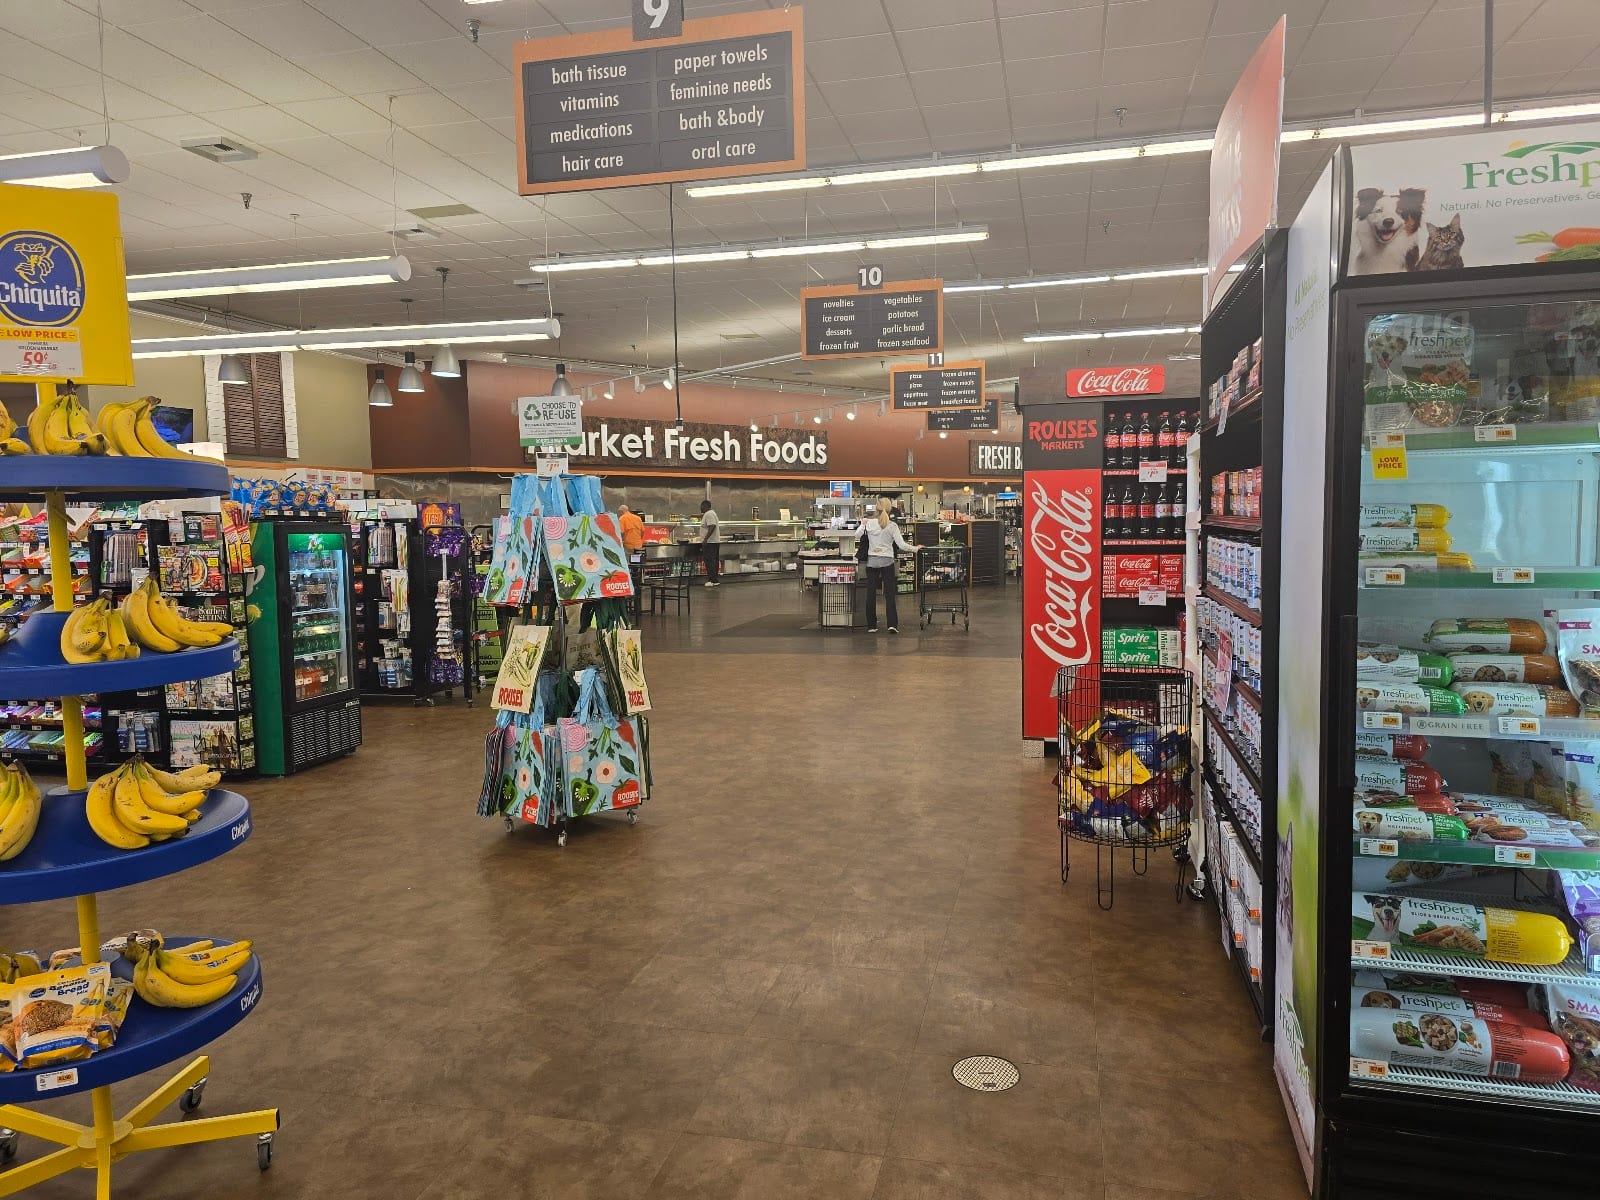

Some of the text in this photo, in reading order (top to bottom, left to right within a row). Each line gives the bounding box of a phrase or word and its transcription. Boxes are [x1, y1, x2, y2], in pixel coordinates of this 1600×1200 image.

[674, 44, 768, 75] paper towels
[551, 64, 627, 85] bath tissue
[670, 74, 772, 101] feminine needs
[560, 93, 619, 113] vitamins
[680, 106, 764, 131] bath &body
[550, 123, 632, 144] medications
[691, 142, 756, 160] oral care
[562, 153, 623, 172] hair care
[1440, 203, 1482, 212] Natural.
[1486, 199, 1502, 208] No
[1506, 192, 1583, 207] Preservatives.
[859, 267, 882, 287] 10
[0, 281, 81, 312] Chiquita
[883, 295, 922, 306] vegetables
[823, 299, 854, 308] novelties
[822, 314, 854, 322] ice cream
[888, 309, 918, 321] potatoes
[6, 329, 67, 339] LOW PRICE
[826, 328, 852, 337] desserts
[882, 322, 924, 336] garlic bread
[819, 340, 859, 351] frozen fruit
[877, 336, 929, 349] frozen seafood
[929, 353, 943, 365] 11
[1077, 367, 1152, 394] Coca-Cola
[541, 401, 577, 410] CHOOSE TO
[542, 409, 577, 421] RE-USE
[1028, 419, 1098, 442] ROUSES
[664, 428, 741, 464] Fresh
[749, 433, 828, 465] Foods
[1041, 440, 1085, 451] MARKETS
[978, 445, 1012, 470] FRESH
[1379, 456, 1400, 464] LOW
[1366, 536, 1399, 548] freshpet
[1119, 557, 1153, 569] Coca-Cola
[1029, 478, 1093, 668] Coca-Cola
[605, 582, 629, 590] ROUSES
[1117, 632, 1150, 645] Sprite
[1118, 652, 1151, 664] Sprite
[498, 687, 524, 707] ROUSES
[1382, 689, 1420, 700] freshpet
[1496, 692, 1536, 704] freshpet
[1427, 721, 1484, 731] GRAIN FREE
[1361, 774, 1396, 786] freshpet
[617, 790, 640, 801] ROUSES
[1385, 813, 1423, 824] freshpet
[1408, 899, 1467, 916] freshpet
[57, 982, 90, 996] Bread
[1401, 994, 1457, 1011] freshpet
